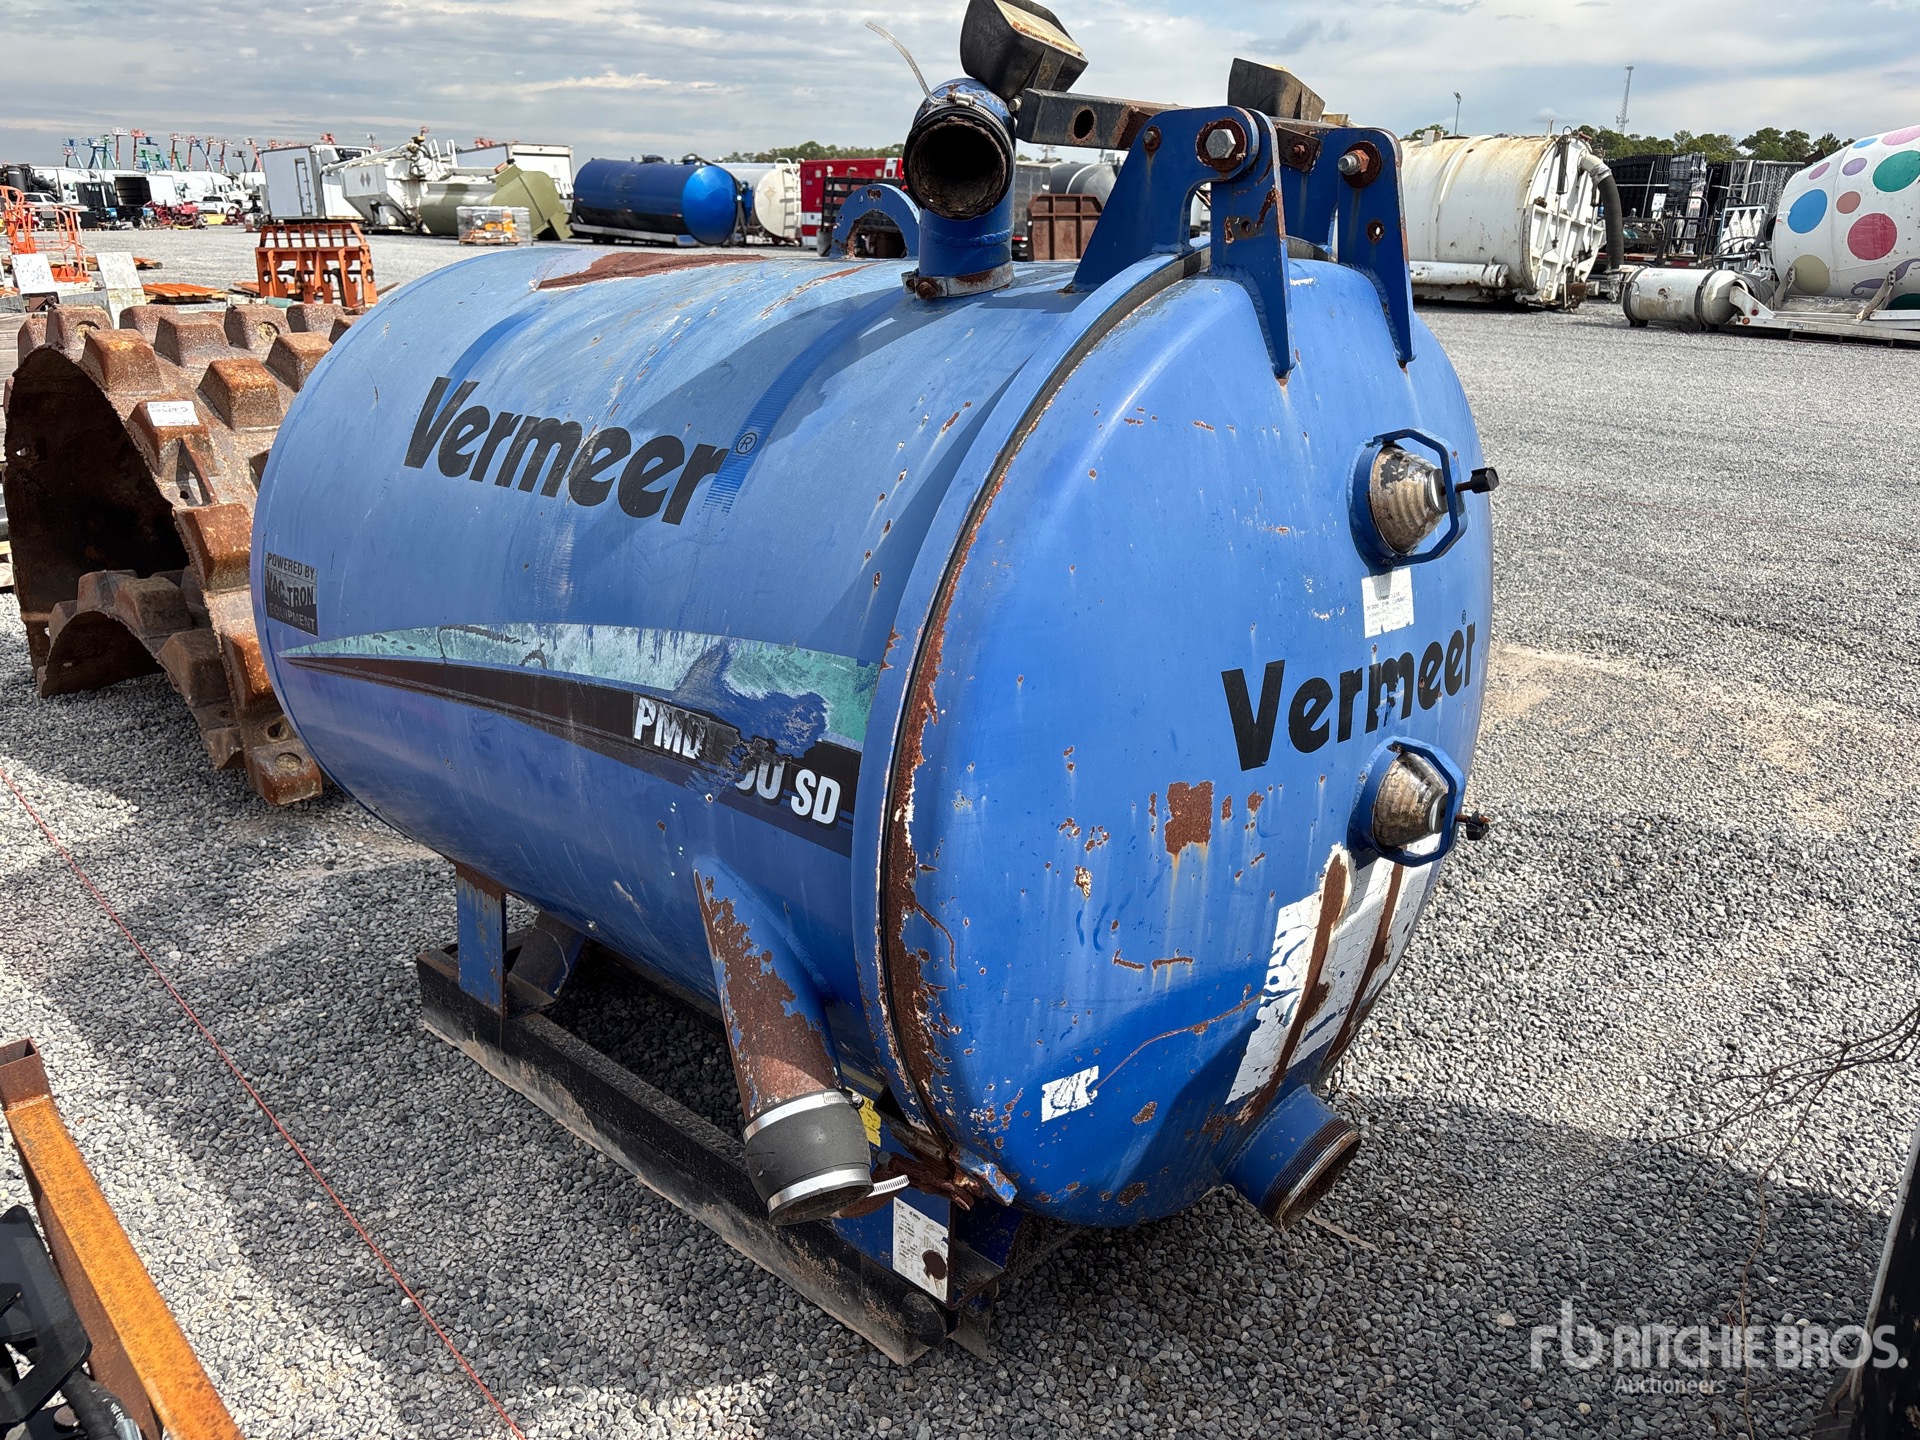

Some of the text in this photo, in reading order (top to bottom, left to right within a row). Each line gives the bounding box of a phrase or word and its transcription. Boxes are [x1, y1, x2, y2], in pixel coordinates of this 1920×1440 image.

[267, 552, 315, 580] POWERED BY
[265, 569, 317, 608] VAC-TRON
[268, 602, 316, 631] EQUIPMENT
[1221, 621, 1476, 772] Vermeer
[790, 769, 841, 825] SD
